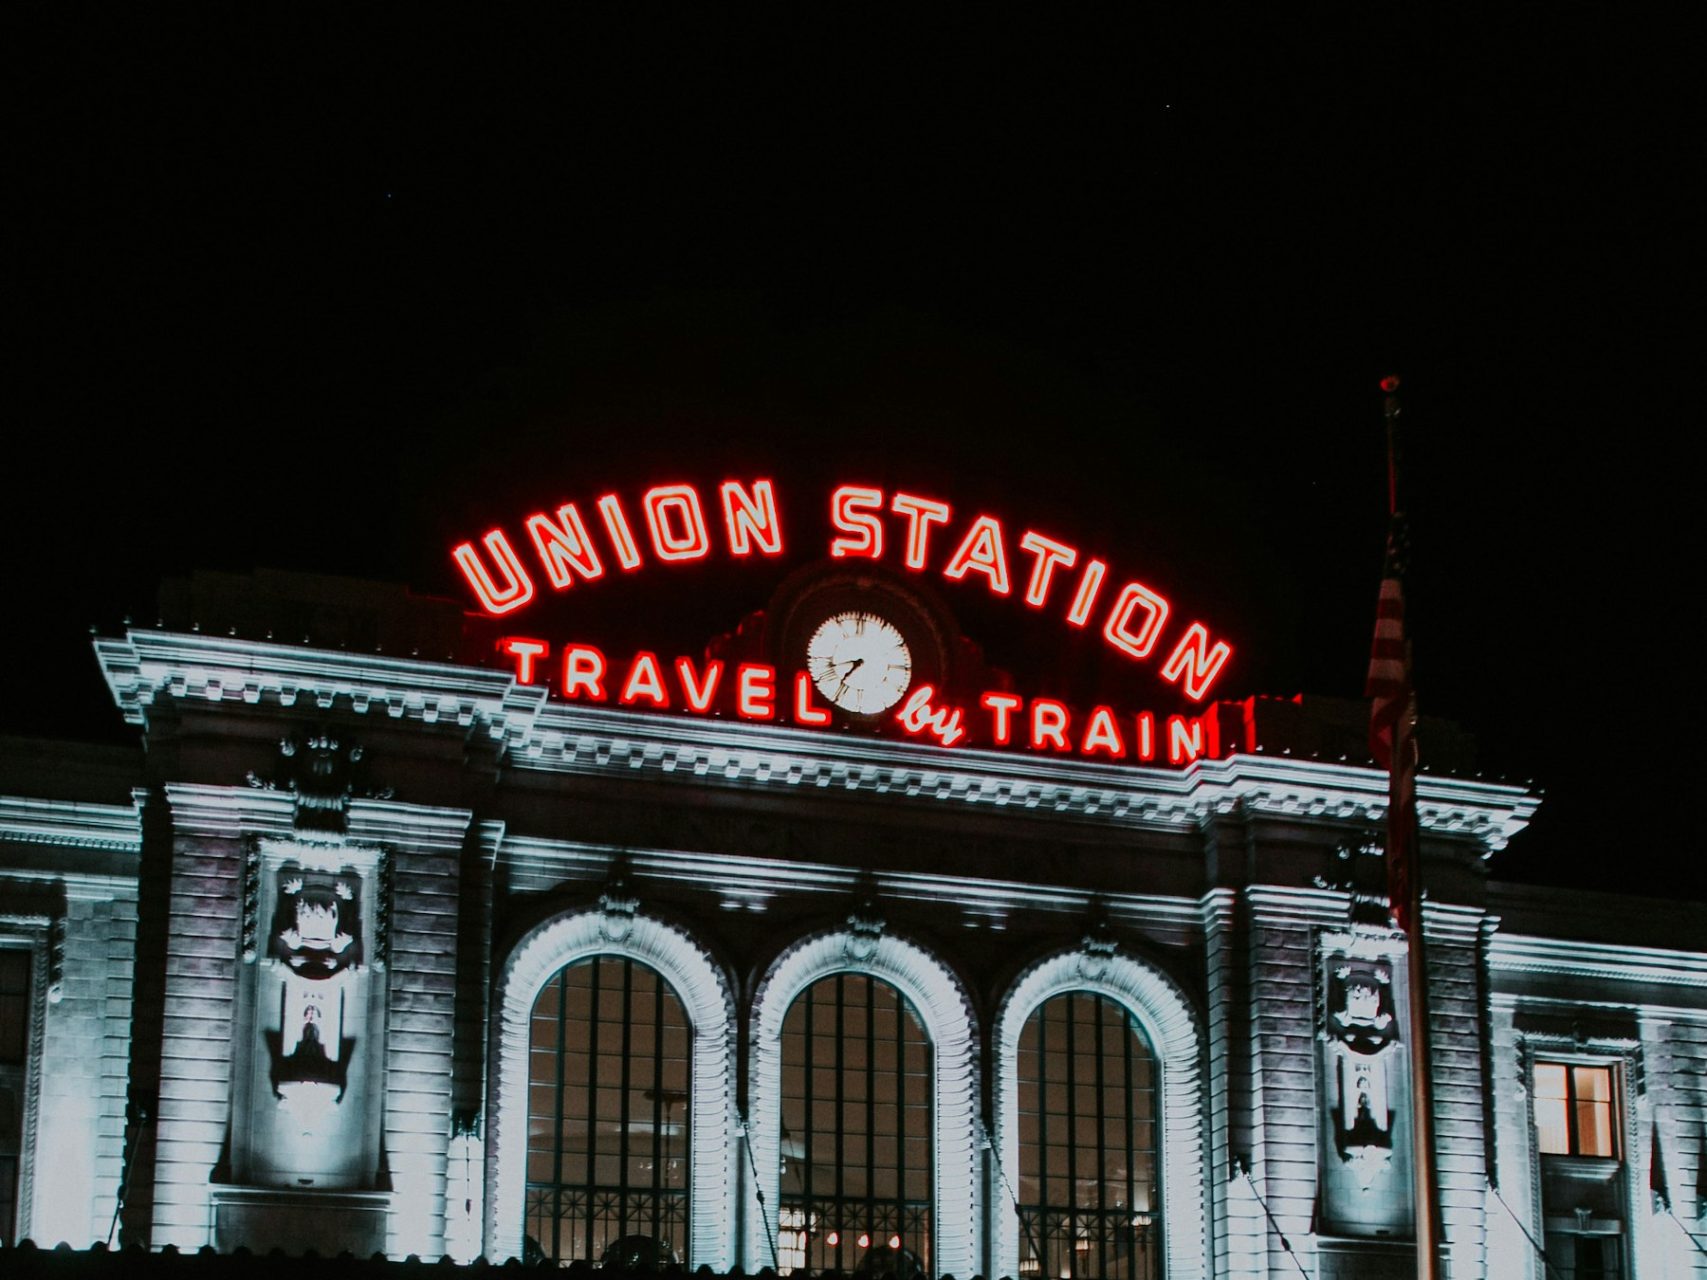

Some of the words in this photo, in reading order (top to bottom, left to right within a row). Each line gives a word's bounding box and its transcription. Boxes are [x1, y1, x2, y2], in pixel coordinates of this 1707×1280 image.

[452, 480, 784, 617] UNION
[830, 485, 1233, 702] STATION
[502, 638, 832, 726] TRAVEL
[896, 683, 965, 747] by
[981, 691, 1201, 764] TRAIN
